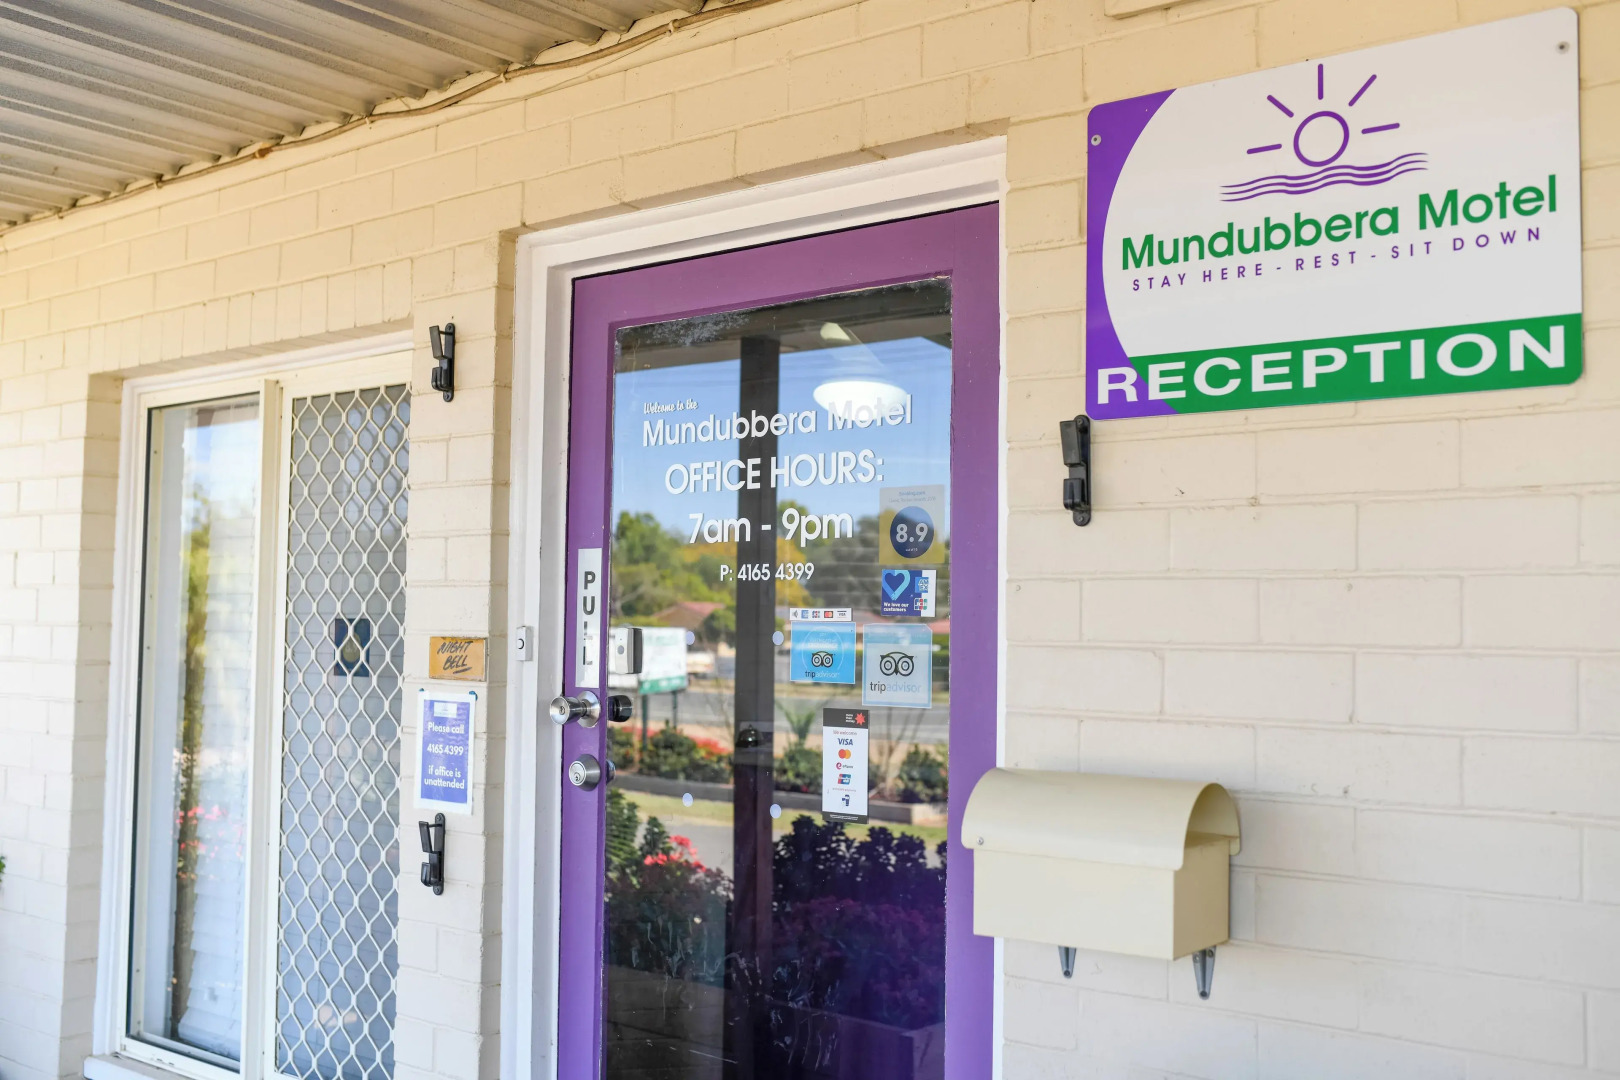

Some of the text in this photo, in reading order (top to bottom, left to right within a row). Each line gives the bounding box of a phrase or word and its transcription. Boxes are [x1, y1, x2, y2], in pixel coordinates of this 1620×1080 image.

[1122, 174, 1556, 270] Mundubbera Motel
[1132, 273, 1187, 291] STAY
[1202, 263, 1263, 283] HERE
[1295, 251, 1356, 271] REST
[1391, 241, 1432, 259] SIT
[1453, 227, 1540, 251] DOWN
[1097, 325, 1565, 404] RECEPTION
[643, 398, 698, 414] Welcome to the
[642, 394, 912, 447] Mundubbera Motel
[664, 449, 885, 495] OFFICE HOURS:
[688, 512, 751, 544] 7am
[781, 508, 853, 547] 9pm
[896, 522, 928, 543] 8.9
[720, 562, 815, 581] P: 4165 4399
[437, 640, 473, 654] NIGHT
[443, 655, 467, 670] BELL
[870, 681, 922, 694] tripadvisor
[427, 721, 465, 734] Please call
[427, 743, 464, 756] 4165 4399
[837, 738, 853, 746] VISA
[428, 765, 461, 778] if office is
[424, 777, 465, 790] unattended
